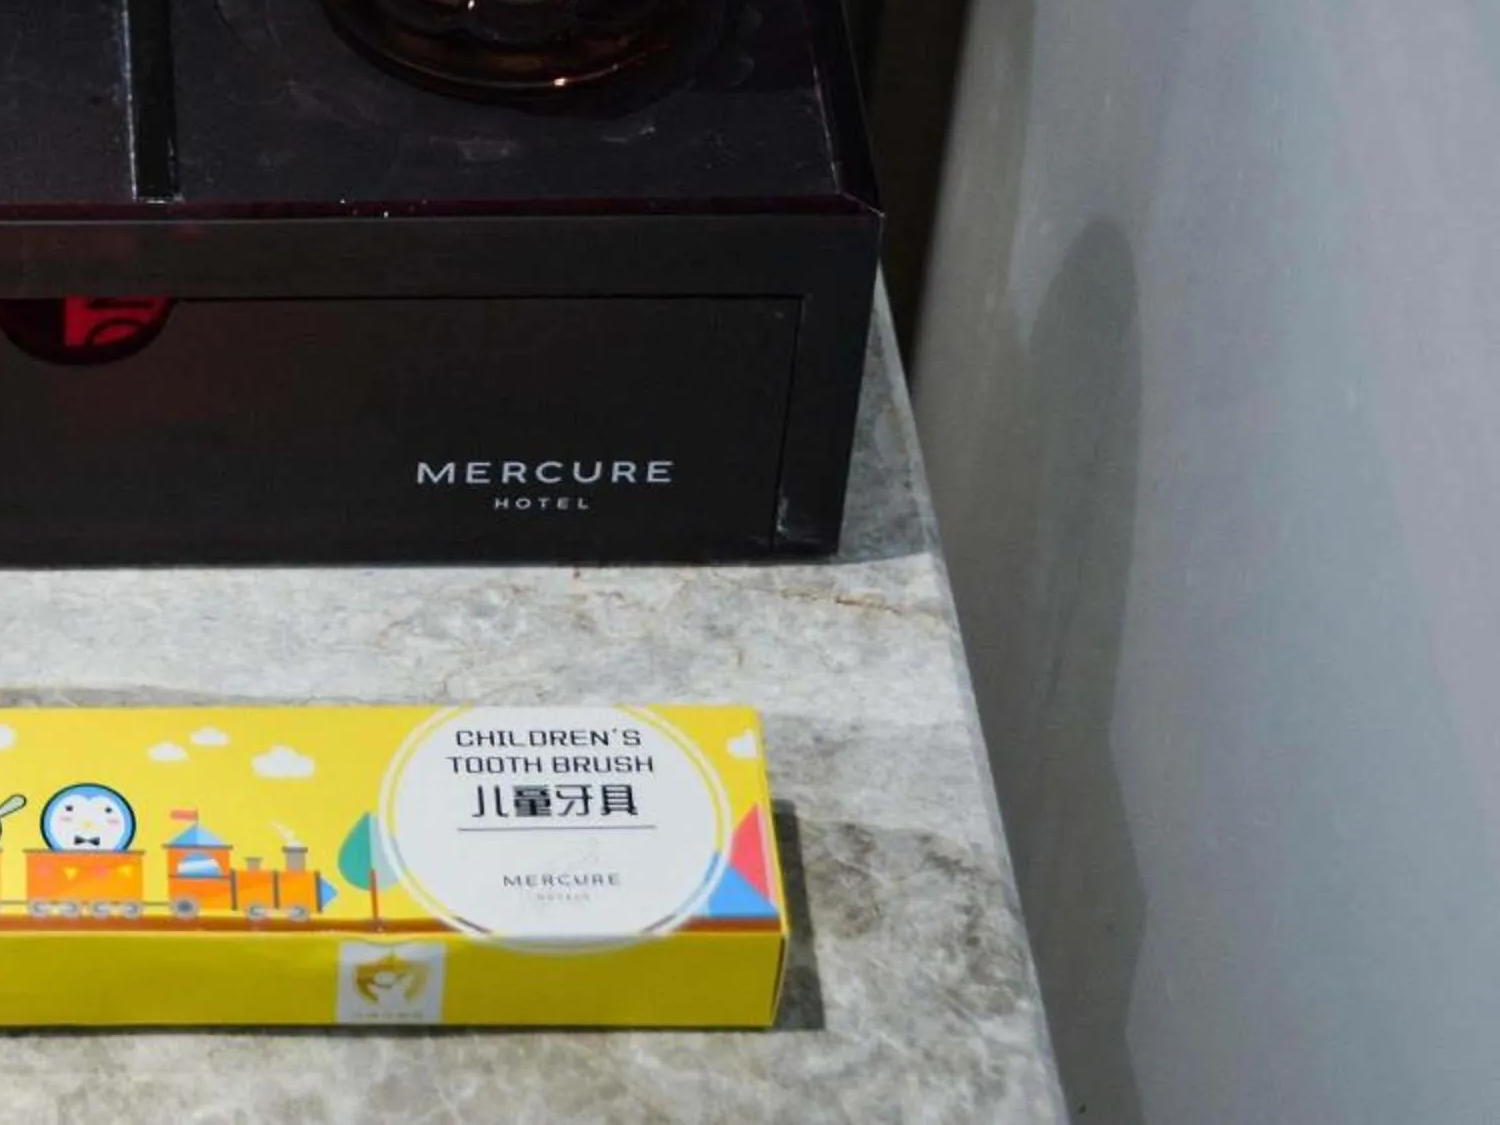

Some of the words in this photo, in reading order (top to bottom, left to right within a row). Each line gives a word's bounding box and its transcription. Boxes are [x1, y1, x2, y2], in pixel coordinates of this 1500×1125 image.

[416, 461, 674, 484] MERCURE
[493, 497, 590, 510] HOTEL
[455, 728, 642, 747] CHILDREN'S
[447, 755, 543, 774] TOOTH
[551, 755, 654, 774] BRUSH
[471, 784, 639, 818] 儿童牙具
[503, 873, 621, 887] MERCURE
